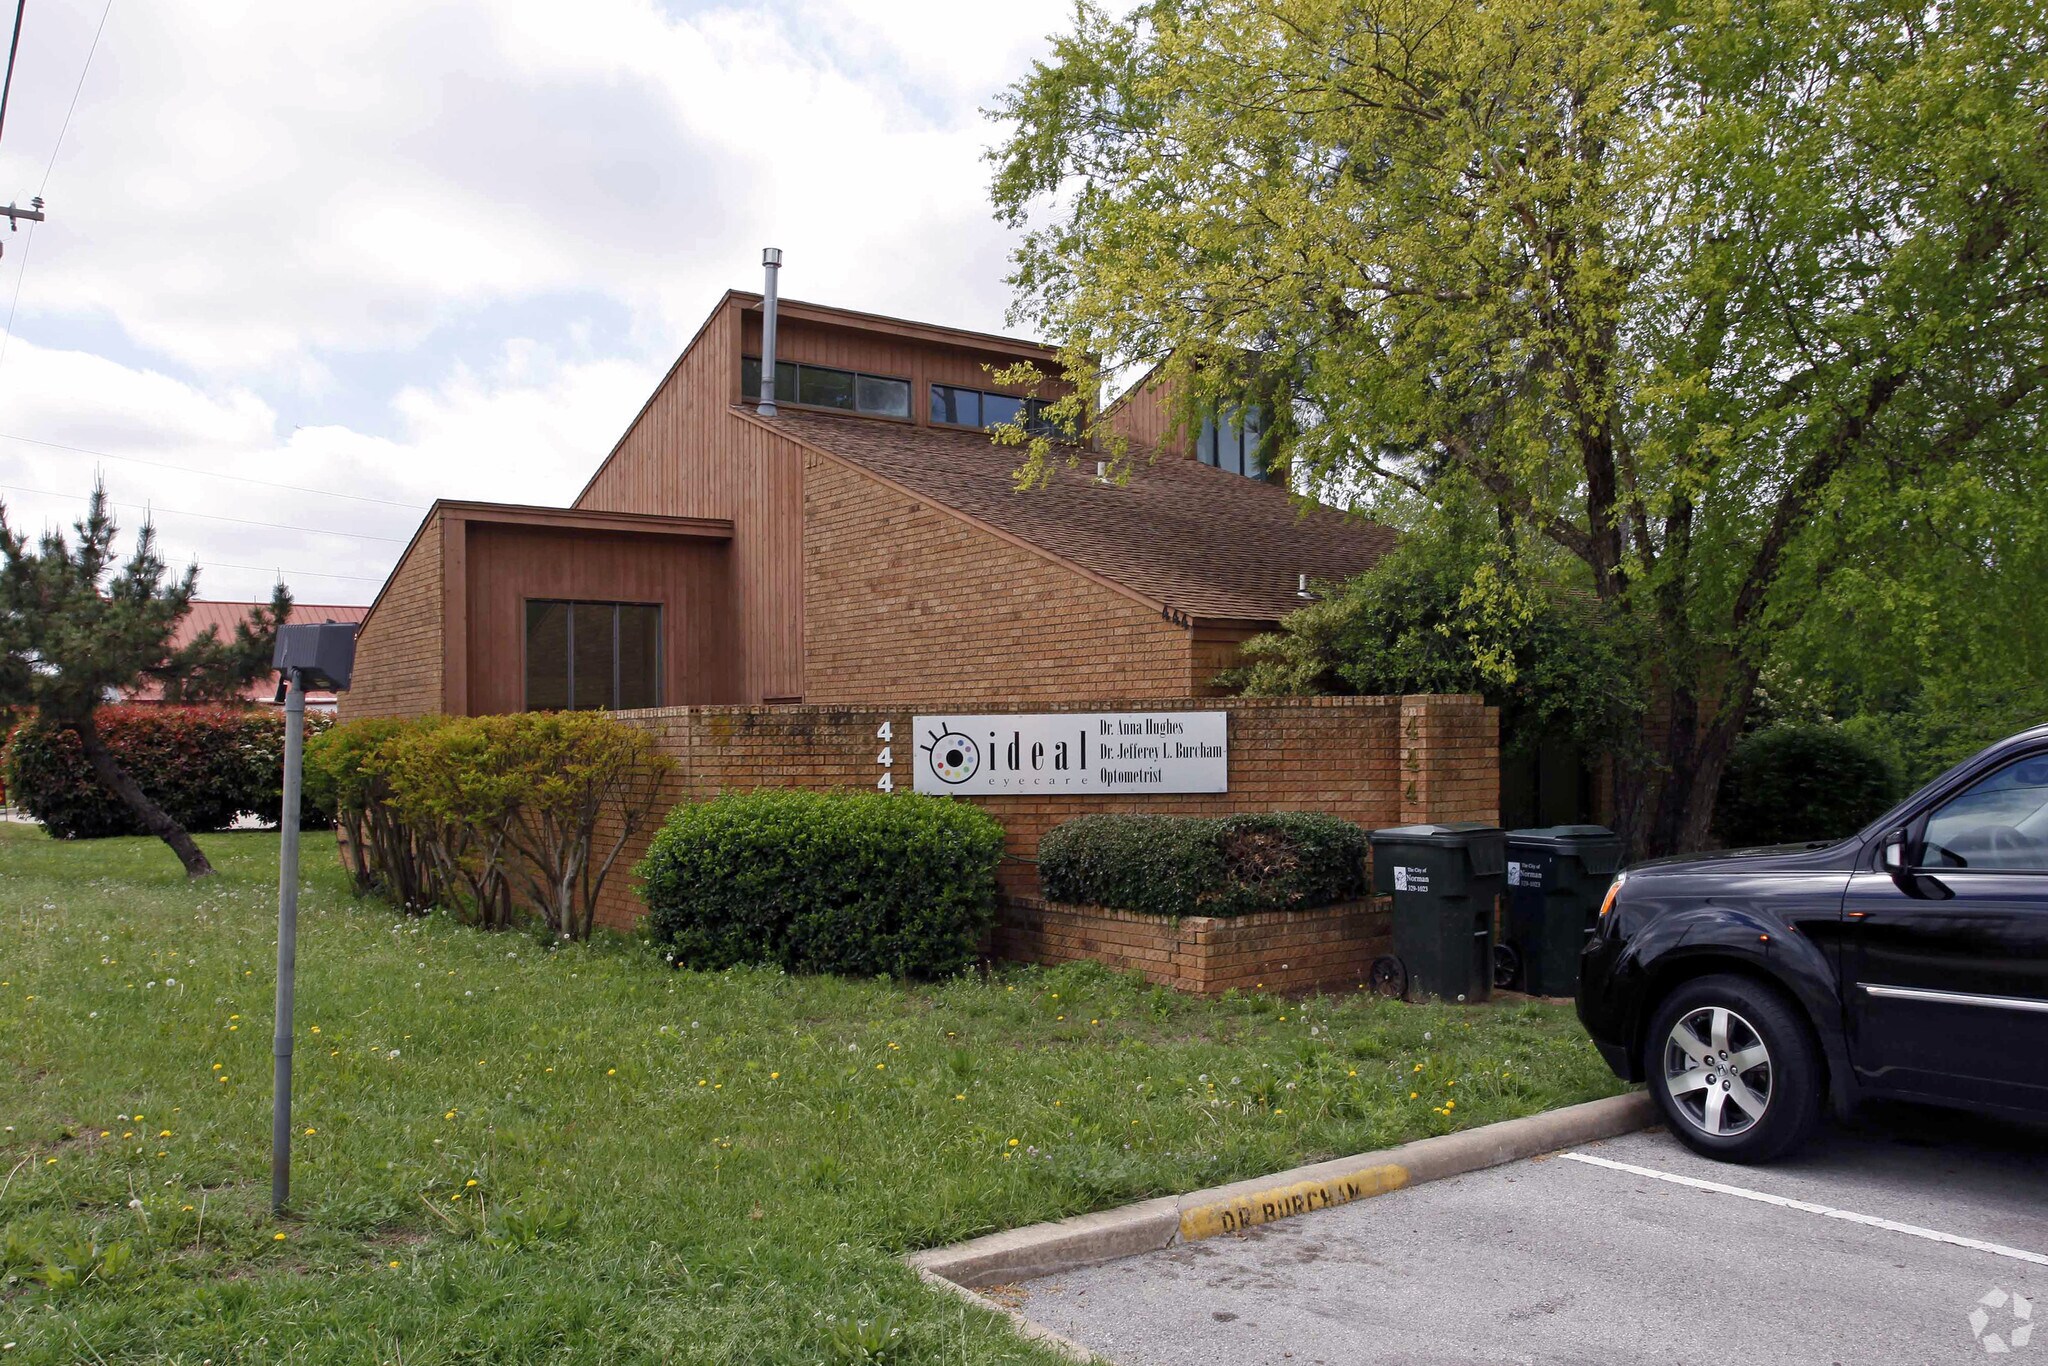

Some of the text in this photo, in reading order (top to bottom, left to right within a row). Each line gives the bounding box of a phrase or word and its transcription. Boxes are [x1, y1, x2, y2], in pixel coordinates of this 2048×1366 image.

[1100, 718, 1184, 738] Dr. Anna Hughes
[876, 721, 893, 792] 444
[989, 731, 1086, 771] ideal
[1100, 742, 1222, 762] Dr. Jefferey L. Burcham
[988, 777, 1088, 787] eyecare
[1100, 766, 1162, 787] Optometrist
[1406, 874, 1430, 883] Norman
[1221, 1182, 1361, 1233] DR BURCHAM
